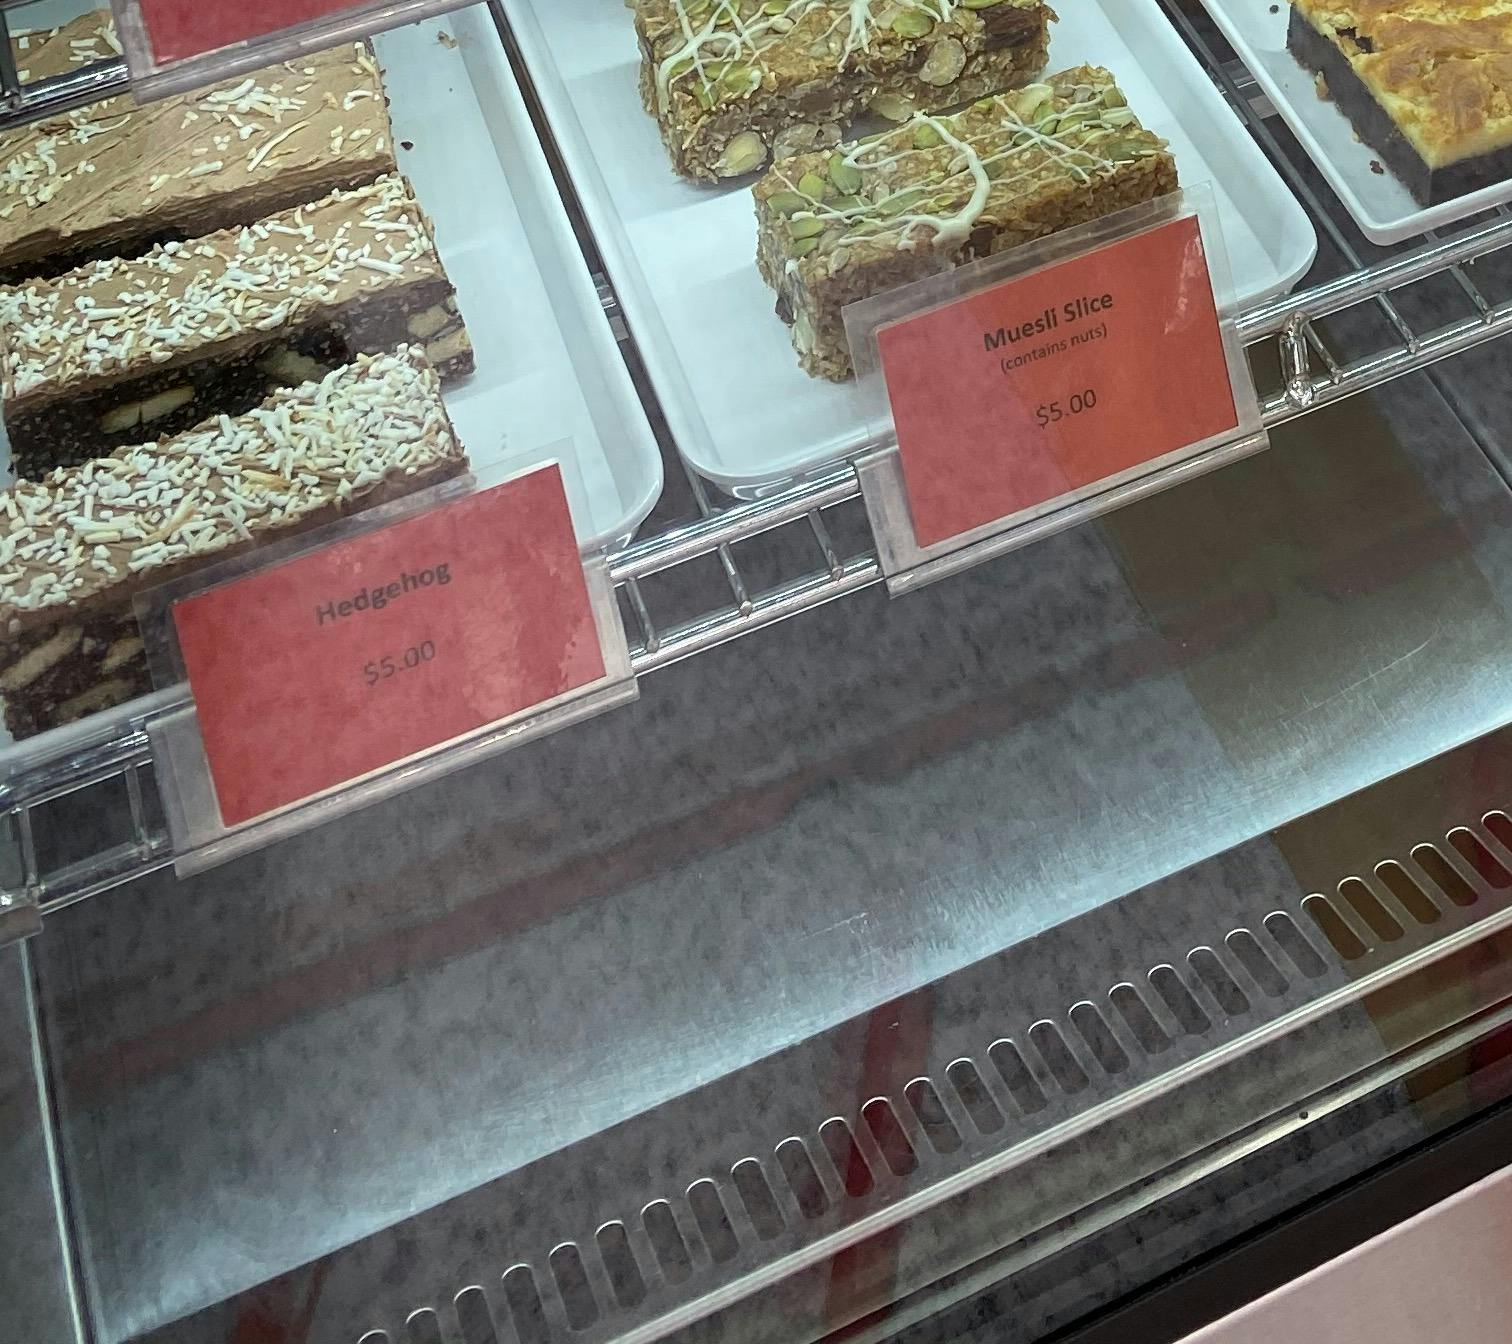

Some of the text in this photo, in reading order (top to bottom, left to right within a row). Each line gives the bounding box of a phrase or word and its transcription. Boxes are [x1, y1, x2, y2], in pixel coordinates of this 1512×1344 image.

[984, 292, 1114, 352] Muesli Slice
[1001, 321, 1108, 375] (contains nuts)
[1036, 389, 1097, 431] $5.00
[315, 563, 452, 626] Hedgehog
[364, 640, 436, 687] $5.00
